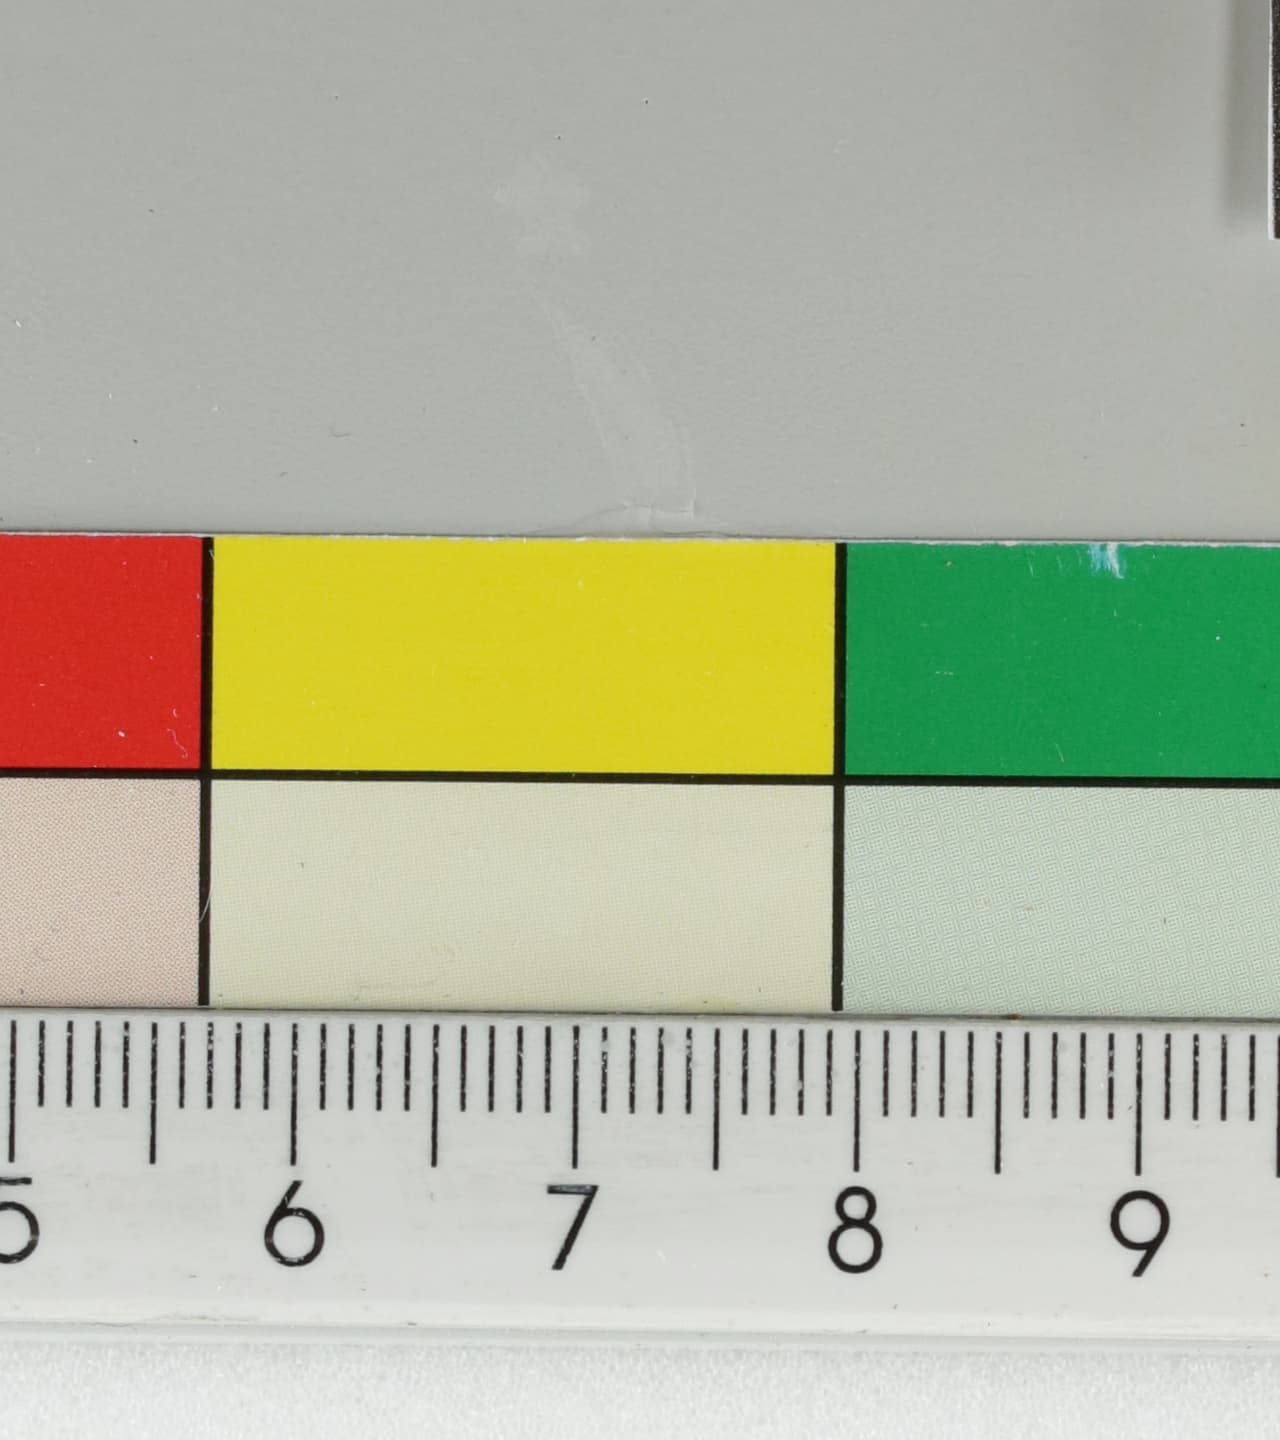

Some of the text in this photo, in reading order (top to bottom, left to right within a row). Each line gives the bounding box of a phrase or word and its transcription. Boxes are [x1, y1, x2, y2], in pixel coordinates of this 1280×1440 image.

[264, 1180, 325, 1267] 6
[547, 1184, 599, 1270] 7
[827, 1186, 883, 1274] 8
[1110, 1190, 1170, 1277] 9
